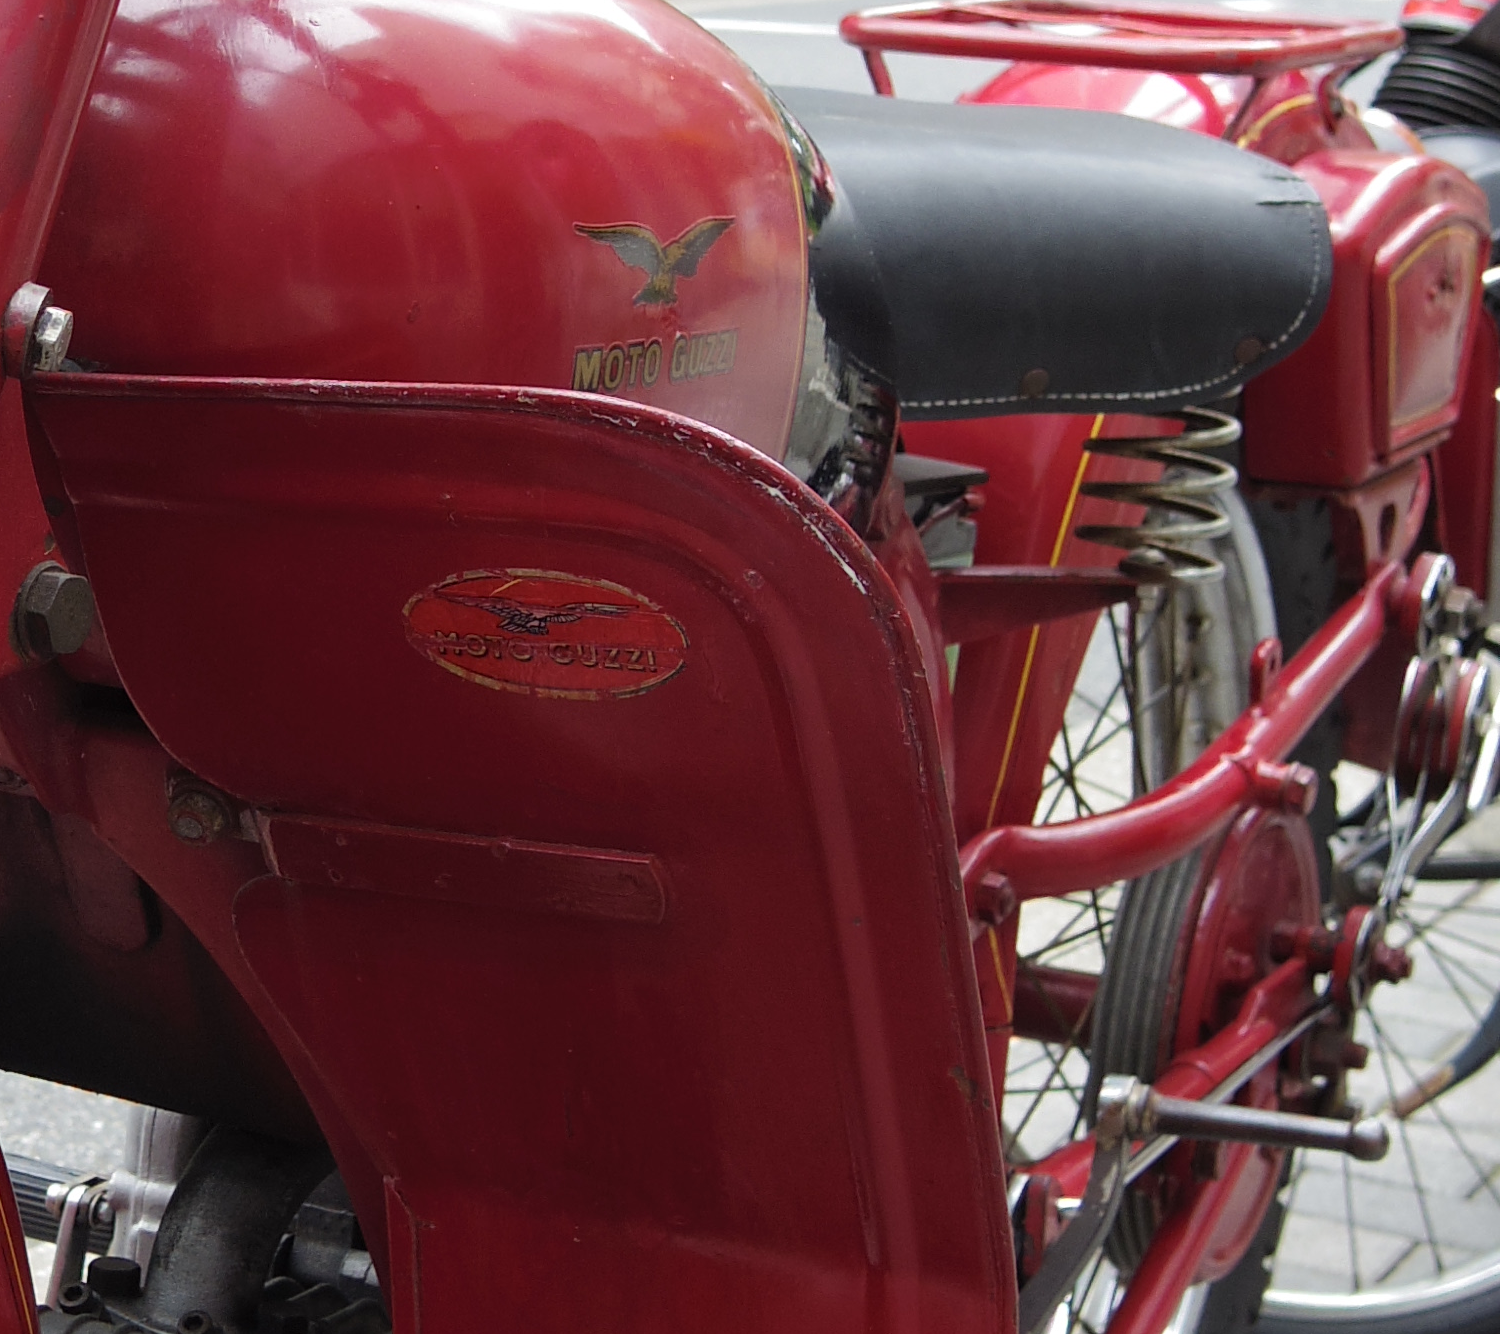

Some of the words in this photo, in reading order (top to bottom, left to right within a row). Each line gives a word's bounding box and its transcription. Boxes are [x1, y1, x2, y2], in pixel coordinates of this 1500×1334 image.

[572, 341, 664, 392] MOTO
[670, 329, 738, 384] GUZZI
[435, 629, 534, 662] MOTO
[548, 642, 659, 673] GUZZI
